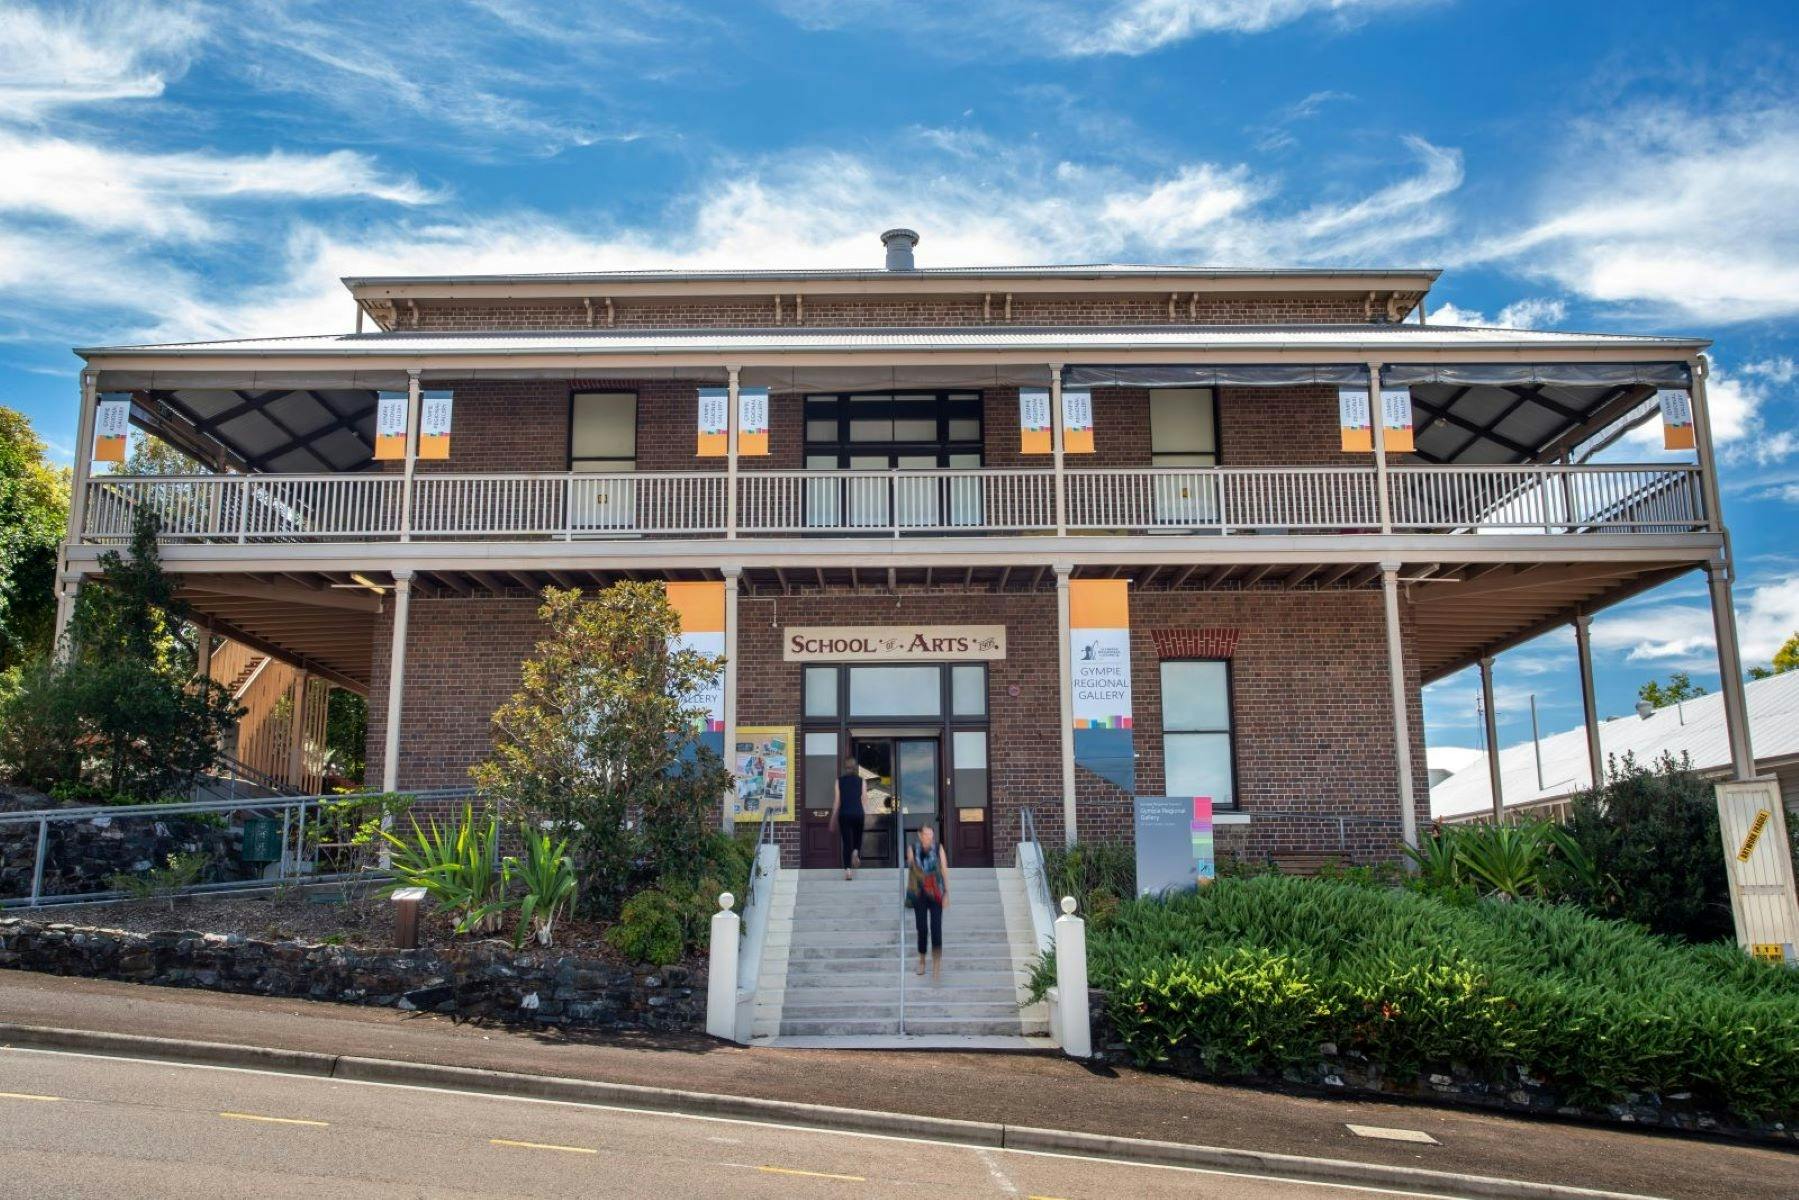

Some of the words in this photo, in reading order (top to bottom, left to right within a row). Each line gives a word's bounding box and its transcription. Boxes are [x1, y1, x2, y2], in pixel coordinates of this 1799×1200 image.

[1080, 667, 1122, 676] GYMPIE
[1074, 679, 1129, 688] REGIONAL
[1078, 690, 1125, 700] GALLERY
